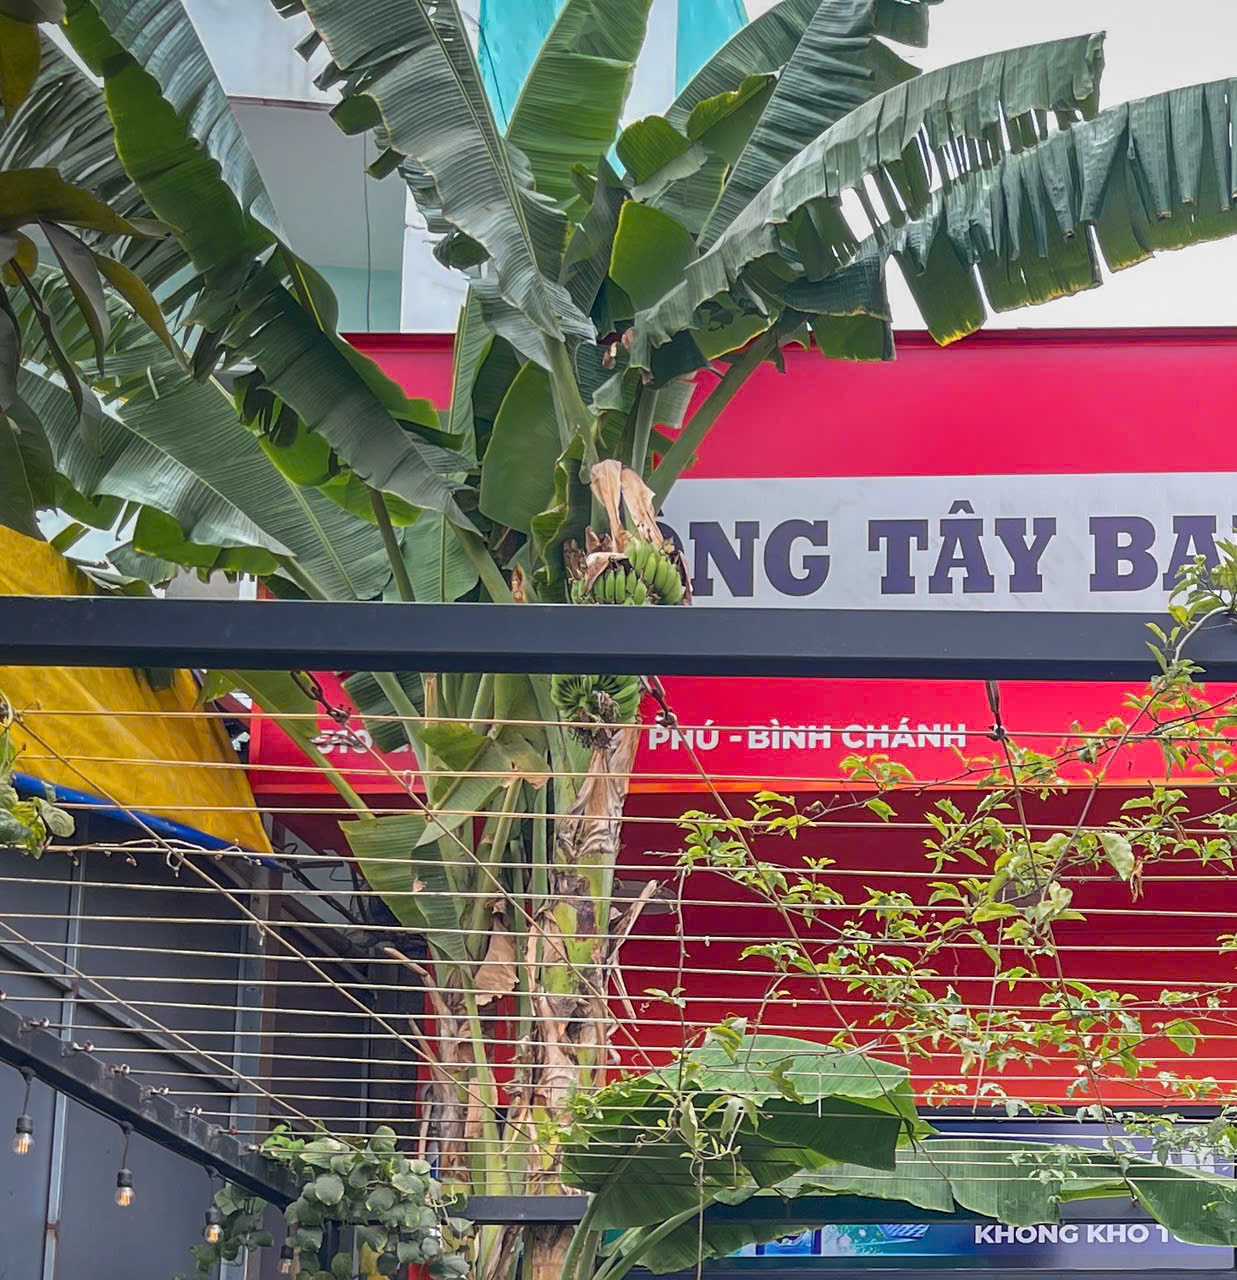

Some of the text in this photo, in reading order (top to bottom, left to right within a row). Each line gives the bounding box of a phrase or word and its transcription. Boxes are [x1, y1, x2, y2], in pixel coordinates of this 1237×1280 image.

[868, 500, 1057, 595] TÂY
[649, 719, 718, 751] PHÚ
[842, 717, 967, 748] CHÁNH
